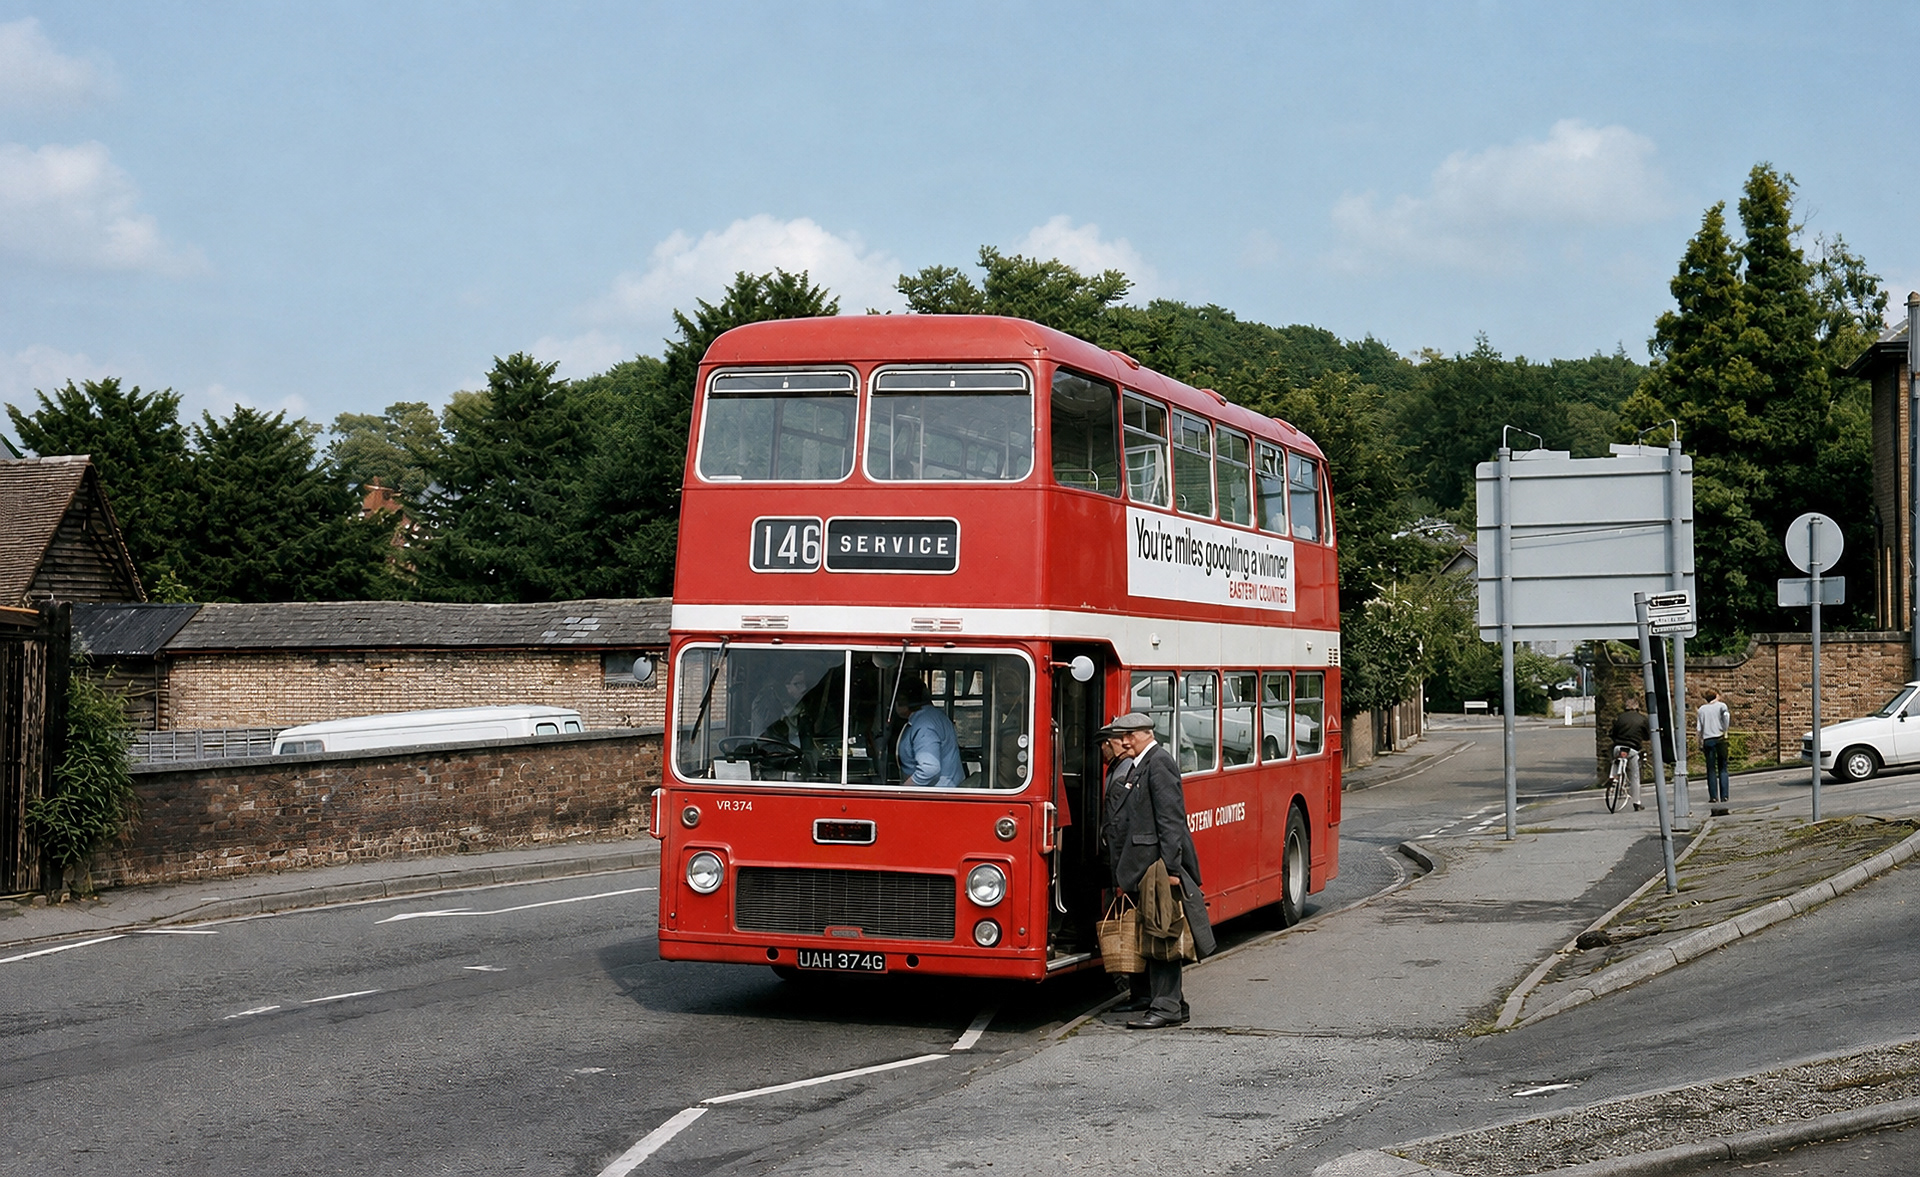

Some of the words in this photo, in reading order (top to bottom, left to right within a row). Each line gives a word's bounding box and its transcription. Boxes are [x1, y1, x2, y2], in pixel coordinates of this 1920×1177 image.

[763, 524, 821, 566] 146
[840, 535, 949, 555] SERVICE
[1135, 516, 1173, 563] You're
[1175, 526, 1204, 567] miles
[1205, 536, 1250, 581] googling
[1251, 550, 1257, 575] a
[1258, 544, 1289, 580] winner
[1229, 580, 1257, 600] EASTERN
[1259, 584, 1288, 604] COUNTIES
[1215, 801, 1246, 827] COUNTIES
[800, 951, 833, 969] UAH
[838, 953, 883, 970] 374G
